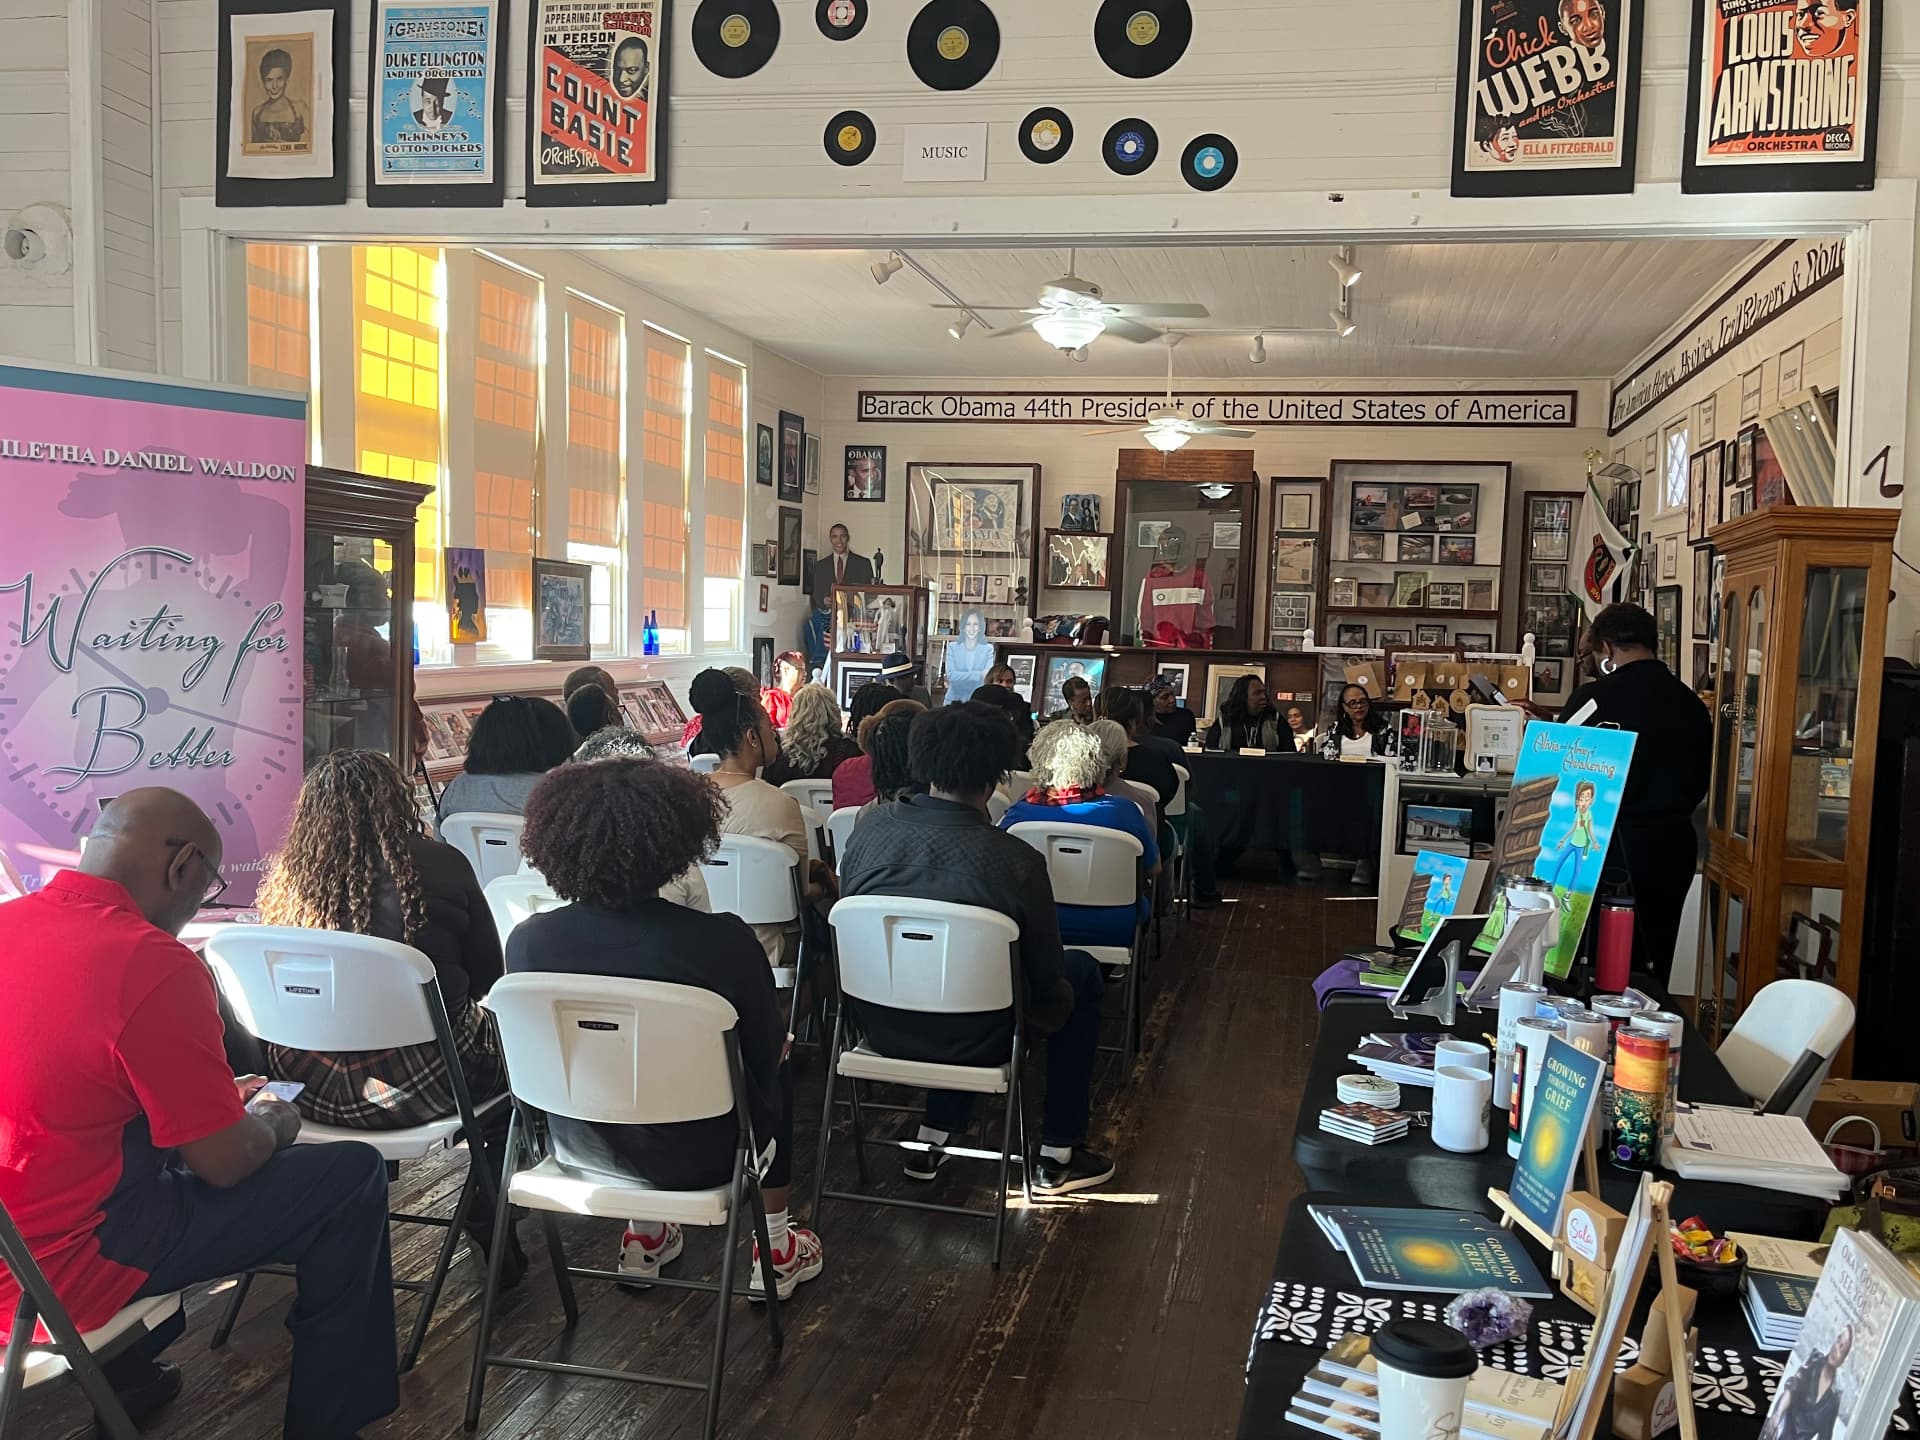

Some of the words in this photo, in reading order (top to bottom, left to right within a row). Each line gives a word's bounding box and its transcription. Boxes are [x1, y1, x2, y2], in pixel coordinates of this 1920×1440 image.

[545, 12, 590, 24] APPEARING
[592, 12, 602, 22] AT
[1722, 0, 1746, 11] KING
[395, 21, 478, 37] GRAYSTONE
[544, 34, 557, 44] IN
[563, 32, 616, 43] PERSON
[1486, 15, 1558, 69] Chick
[1728, 10, 1795, 65] LOUIS
[385, 53, 417, 68] DUKE
[420, 52, 485, 67] ELLINGTON
[406, 70, 423, 78] HIS
[424, 69, 483, 78] ORCHESTRA
[1475, 41, 1610, 117] WEBB
[547, 63, 642, 136] COUNT
[1519, 108, 1541, 128] and
[1541, 105, 1555, 118] his
[1557, 80, 1616, 110] Orchestra
[1711, 54, 1856, 141] ARMSTRONG
[550, 98, 633, 168] BASIE
[1747, 141, 1818, 151] ORCHESTRA
[1826, 133, 1851, 142] DECCA
[385, 145, 430, 153] COTTON
[431, 144, 482, 153] PICKERS
[541, 146, 600, 168] ORCHESTRA
[921, 146, 968, 159] MUSIC
[1523, 143, 1548, 155] ELLA
[1550, 142, 1614, 155] FITZGERALD
[1790, 260, 1801, 300] &
[863, 396, 933, 416] Barack
[942, 396, 1016, 418] Obama
[1024, 398, 1072, 418] 44th
[1082, 397, 1184, 418] Presidet
[1192, 398, 1216, 418] of
[1223, 398, 1259, 419] the
[1268, 399, 1343, 420] United
[1352, 400, 1425, 420] States
[1435, 399, 1460, 420] of
[1467, 400, 1566, 421] America
[103, 450, 193, 473] DANIEL
[199, 458, 297, 481] WALDON
[848, 450, 882, 460] OBAMA
[0, 546, 226, 691] Waiting
[222, 601, 289, 704] for
[41, 686, 237, 792] Better
[1562, 750, 1616, 779] Awakening
[1547, 1056, 1587, 1089] GROWING
[1548, 1073, 1579, 1098] THROUGH
[1545, 1087, 1572, 1112] GRIEF
[1462, 1243, 1490, 1275] GRIEF
[1476, 1242, 1505, 1278] THROUGH
[1486, 1237, 1523, 1285] GROWING
